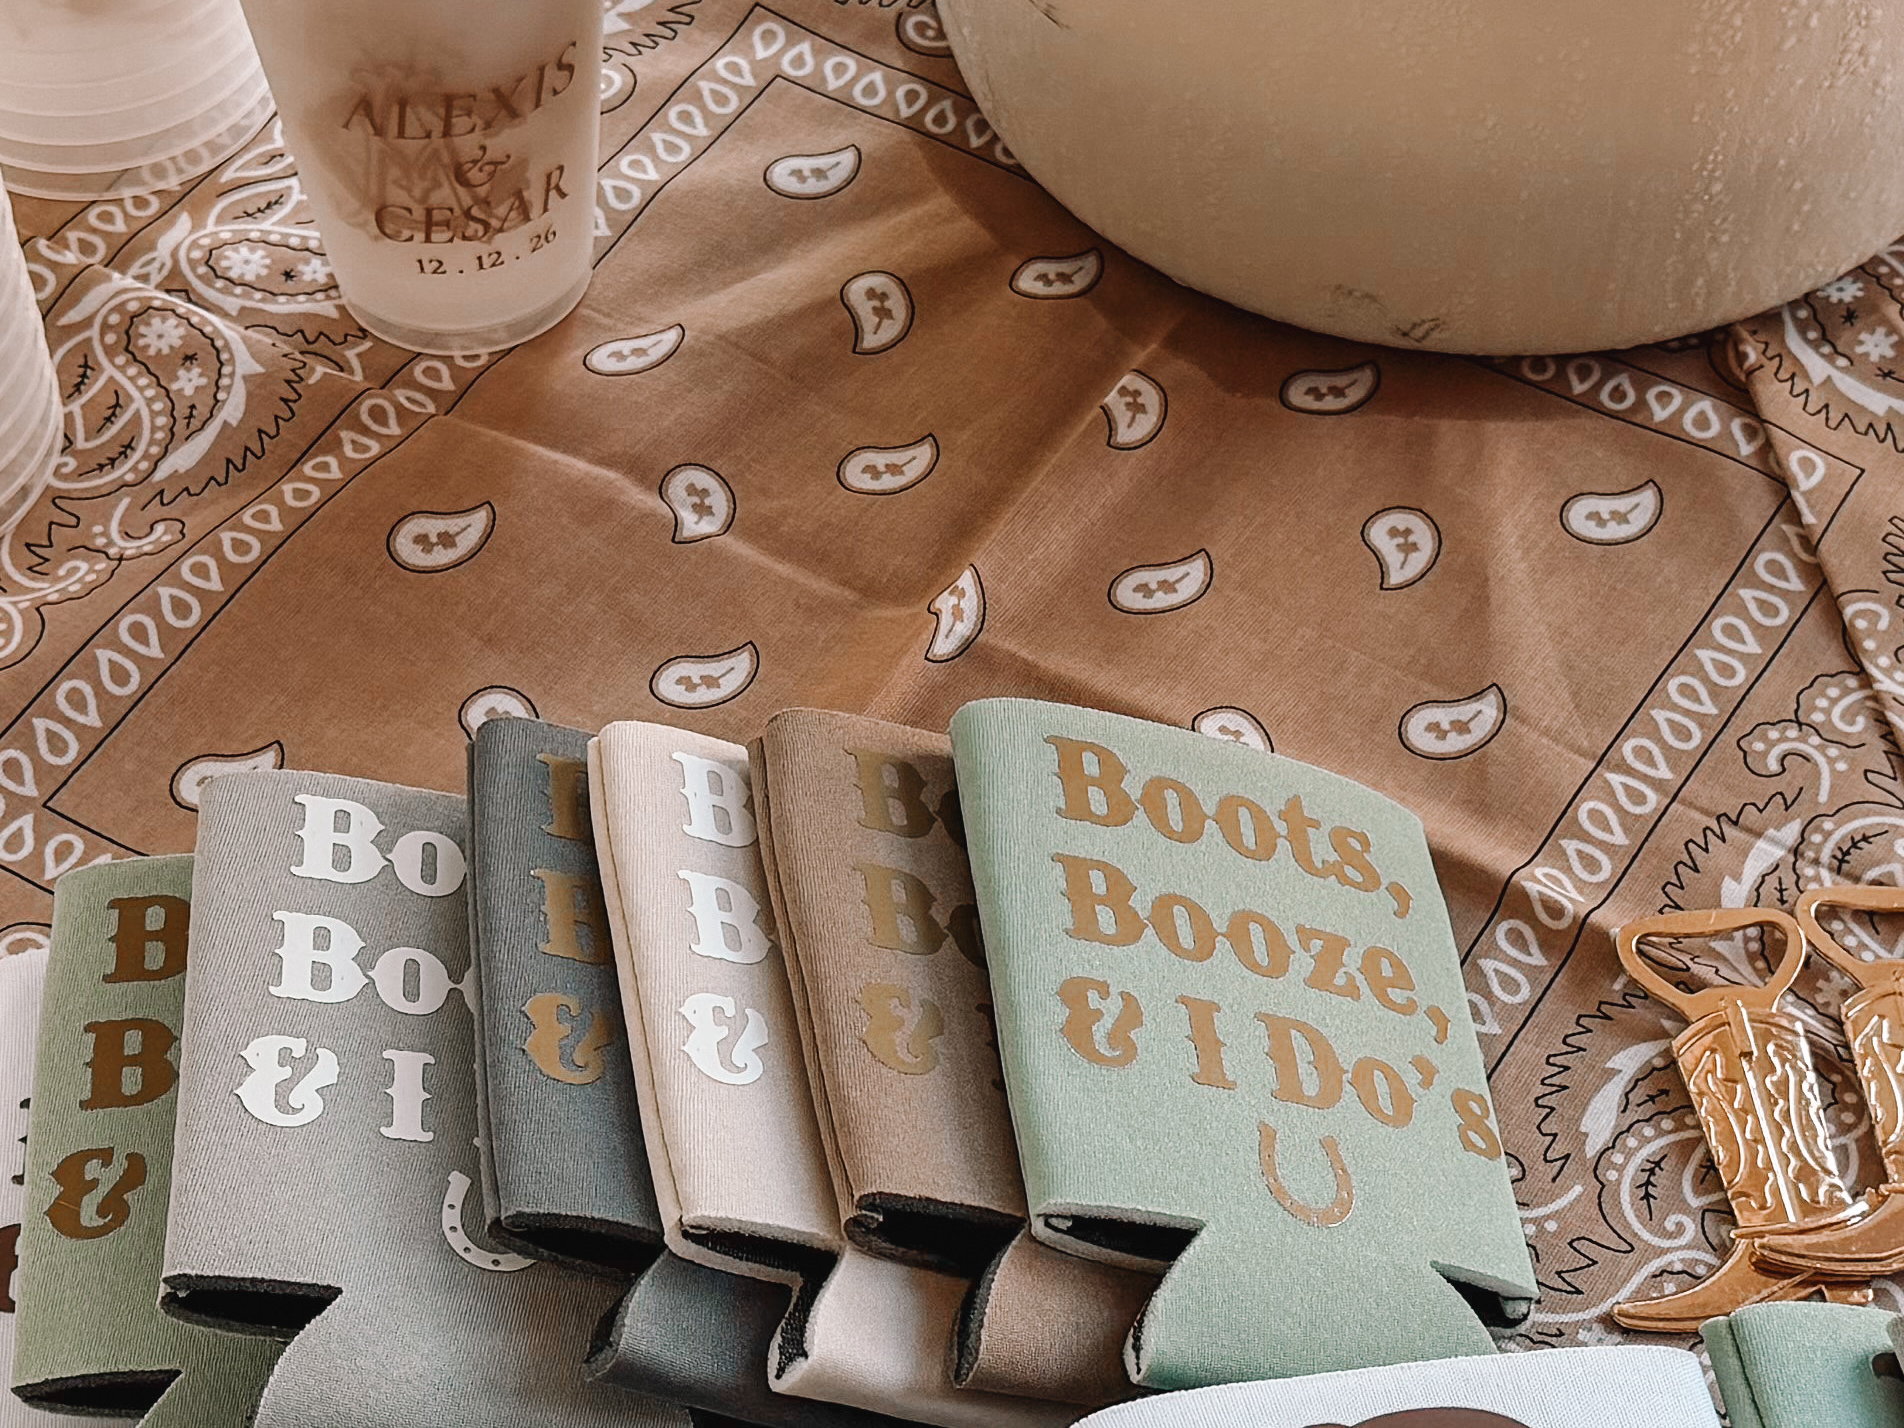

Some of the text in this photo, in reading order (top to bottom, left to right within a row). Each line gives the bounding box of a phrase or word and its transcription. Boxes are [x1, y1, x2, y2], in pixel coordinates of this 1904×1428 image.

[341, 40, 577, 140] ALEXIS
[374, 164, 568, 244] CESAR
[453, 144, 511, 188] &
[1045, 734, 1414, 920] Boots,
[269, 910, 480, 1015] Bo
[1051, 852, 1450, 1045] Booze,
[235, 1034, 340, 1128] &
[677, 992, 770, 1086] &
[1056, 976, 1501, 1162] & I Do's
[42, 1147, 146, 1240] &
